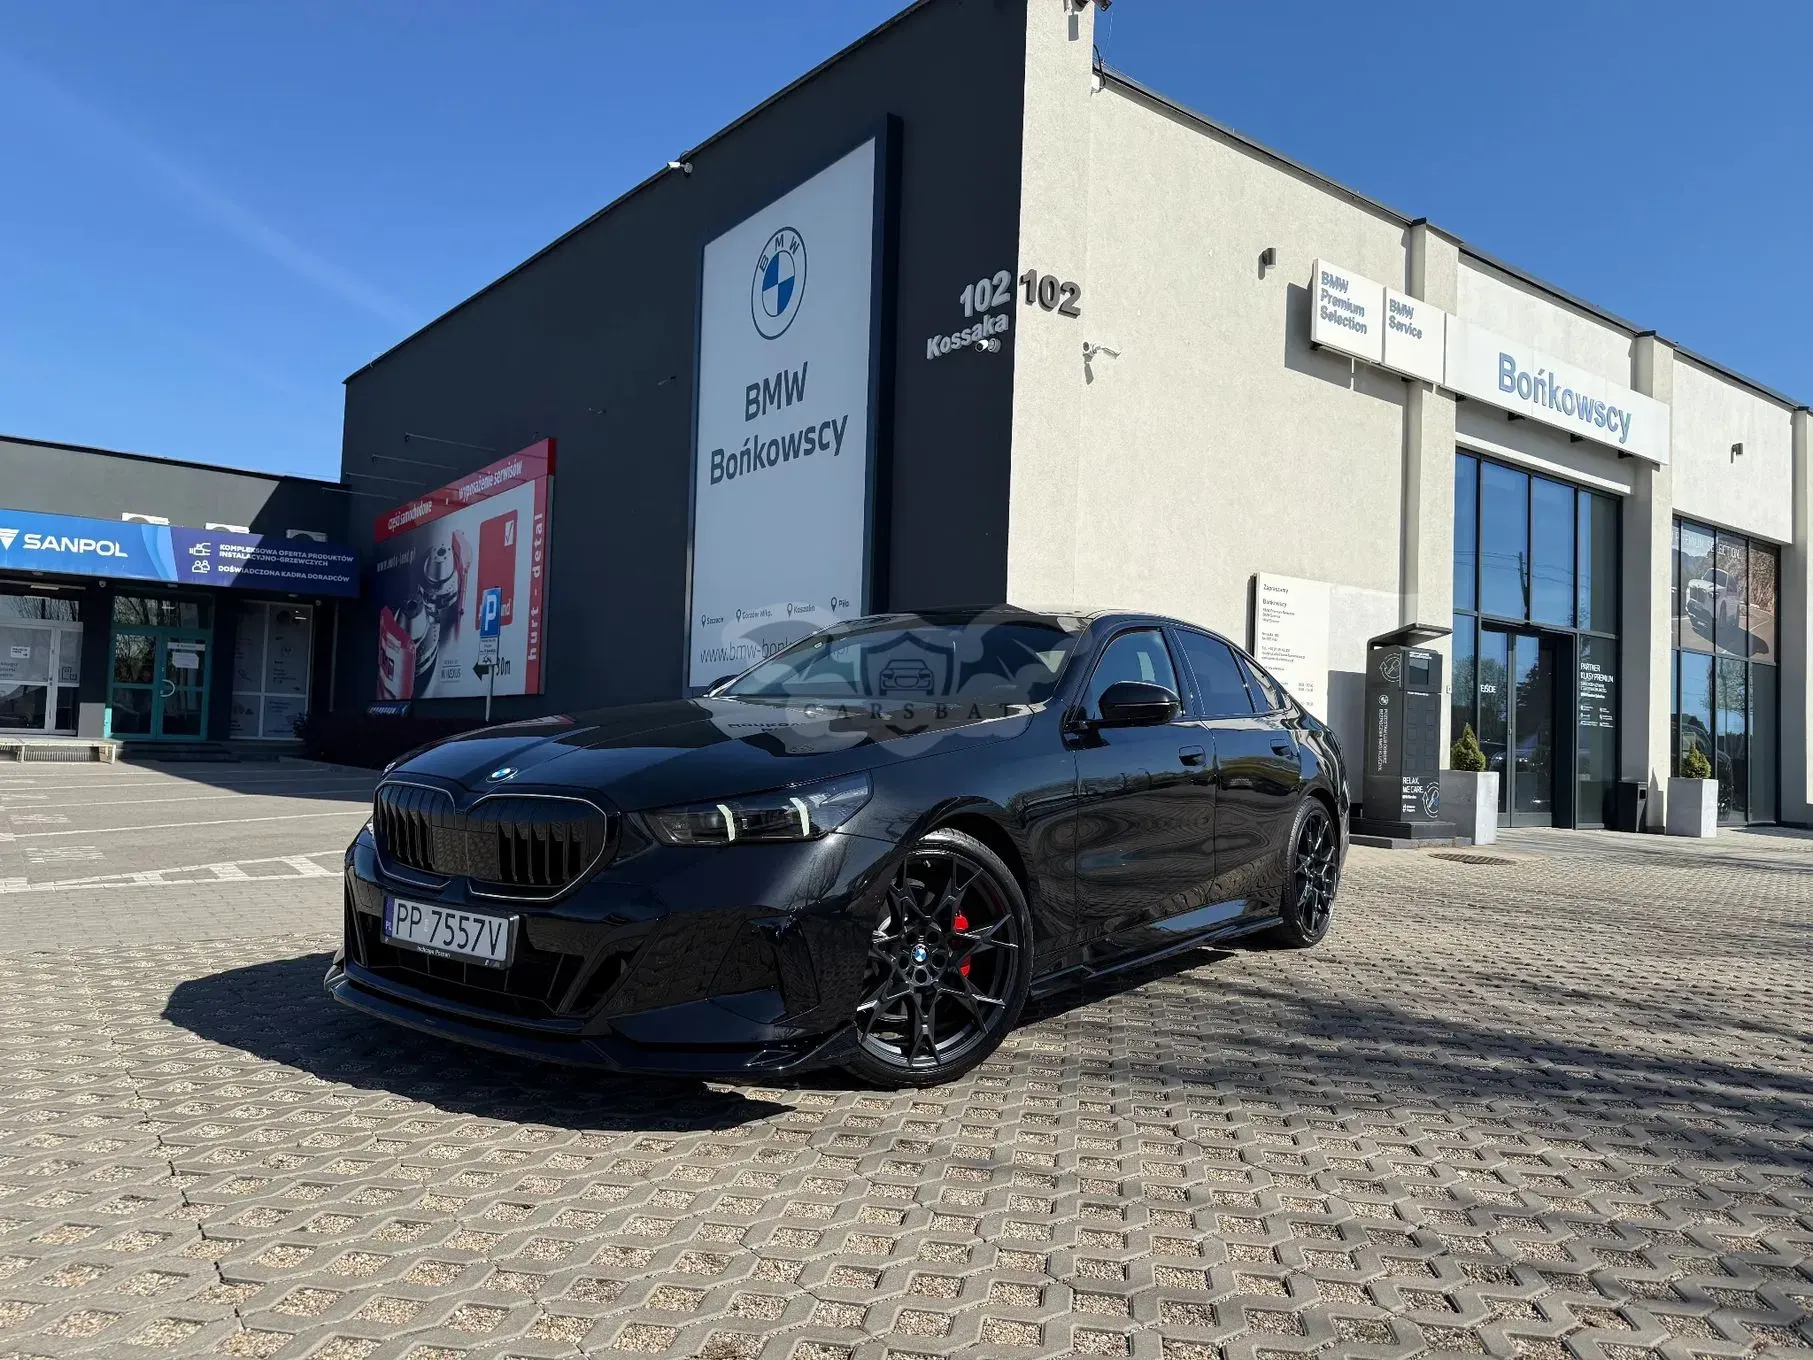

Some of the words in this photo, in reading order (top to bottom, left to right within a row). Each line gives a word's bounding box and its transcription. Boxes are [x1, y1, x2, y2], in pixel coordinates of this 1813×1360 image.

[759, 234, 800, 272] BMW
[960, 269, 1011, 318] 102
[1019, 268, 1081, 319] 102
[1321, 270, 1349, 294] BMW
[1320, 287, 1365, 317] Premium
[1389, 298, 1414, 320] BMW
[926, 313, 1009, 360] Kossaka
[1320, 305, 1367, 335] Selection
[1388, 315, 1423, 339] Service
[744, 360, 809, 422] BMW
[1498, 351, 1633, 444] Bońkowscy
[710, 414, 849, 486] Bońkowscy
[22, 533, 129, 558] SANPOL
[219, 543, 278, 556] KOMPLEKSOWA
[278, 549, 307, 558] OFERTA
[307, 552, 354, 562] PRODUKTÓW
[219, 551, 328, 567] INSTALACYJNO-GRZEWCZYCH
[218, 564, 280, 577] DOŚWIADCZONA
[281, 571, 307, 579] KADRA
[307, 572, 350, 582] DORADCÓW
[484, 594, 497, 631] P
[396, 903, 422, 938] PP
[429, 909, 502, 956] 7557V
